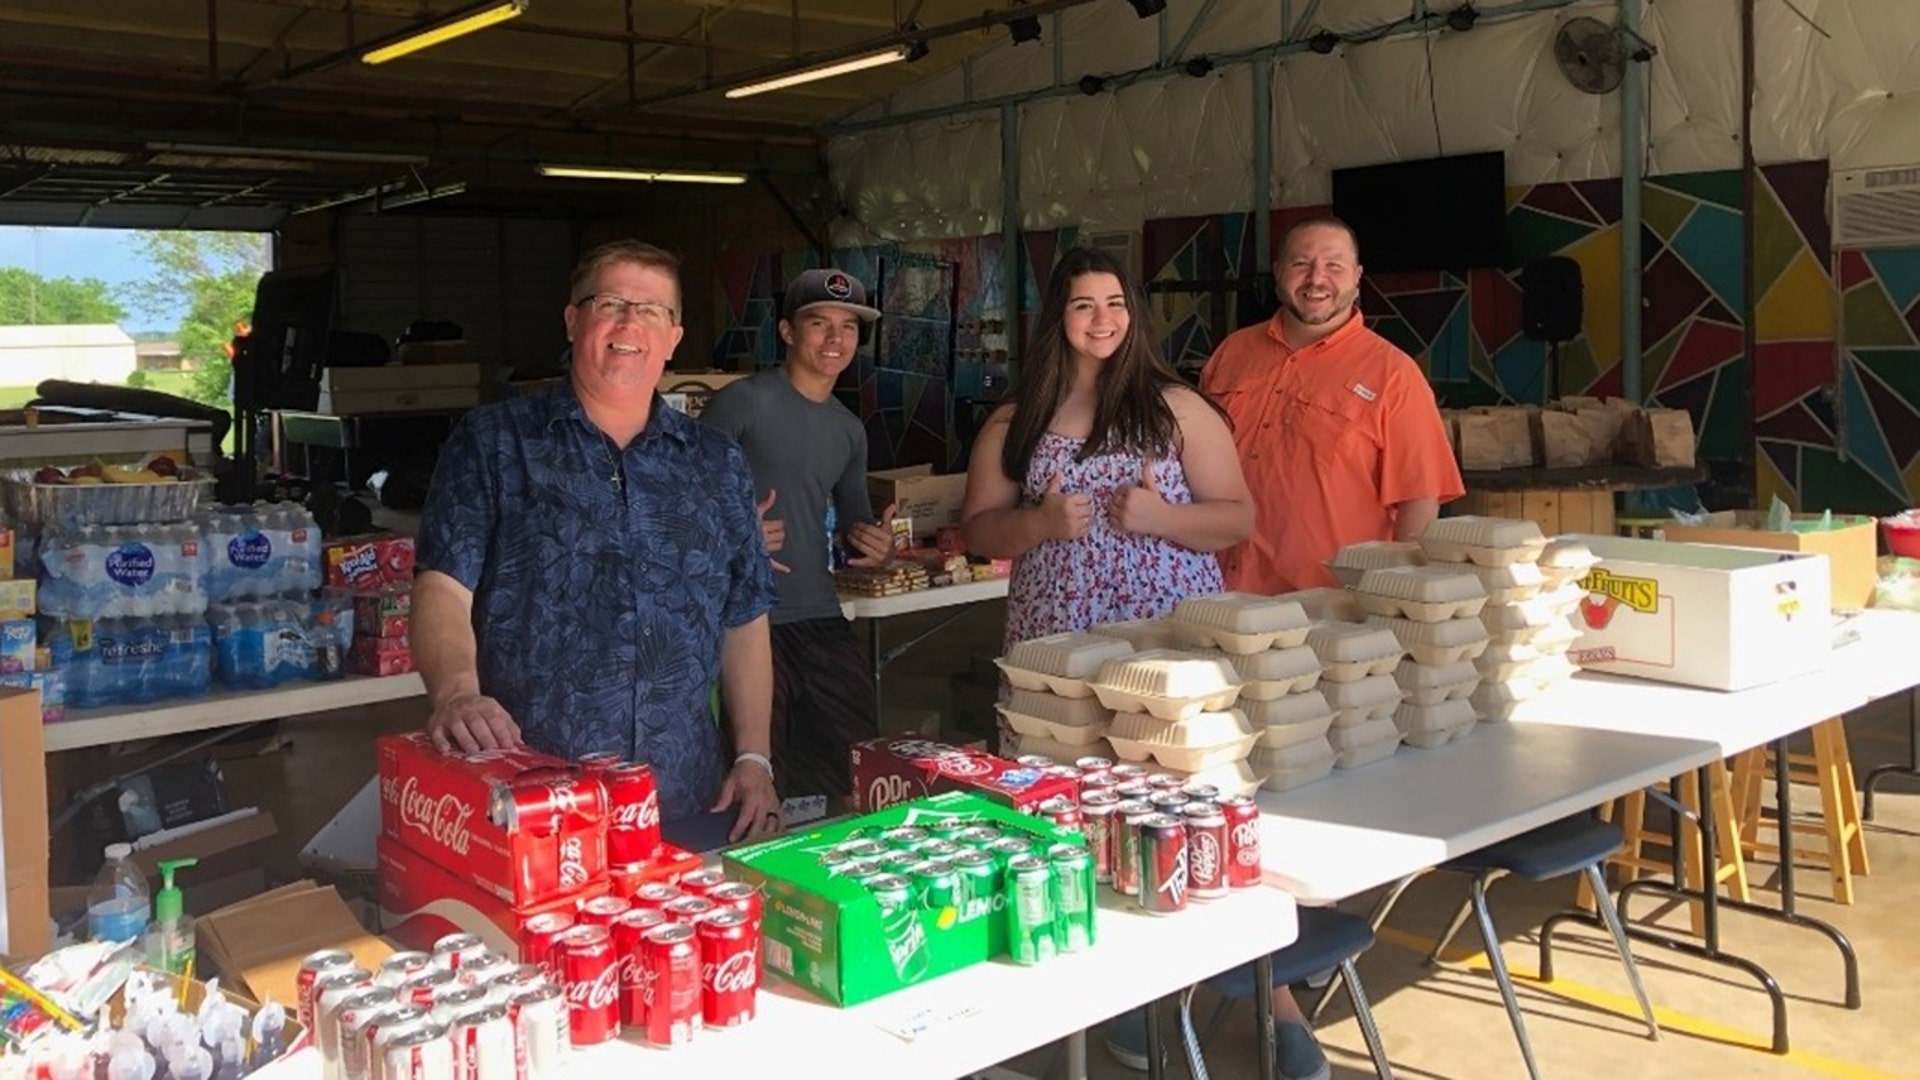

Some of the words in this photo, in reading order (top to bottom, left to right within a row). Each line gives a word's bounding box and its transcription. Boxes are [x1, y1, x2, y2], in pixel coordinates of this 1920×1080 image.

[109, 556, 152, 568] Purified
[113, 567, 149, 577] Water
[1592, 572, 1652, 609] FRUITS
[889, 774, 911, 802] Dr
[401, 776, 475, 856] Coca-Cola
